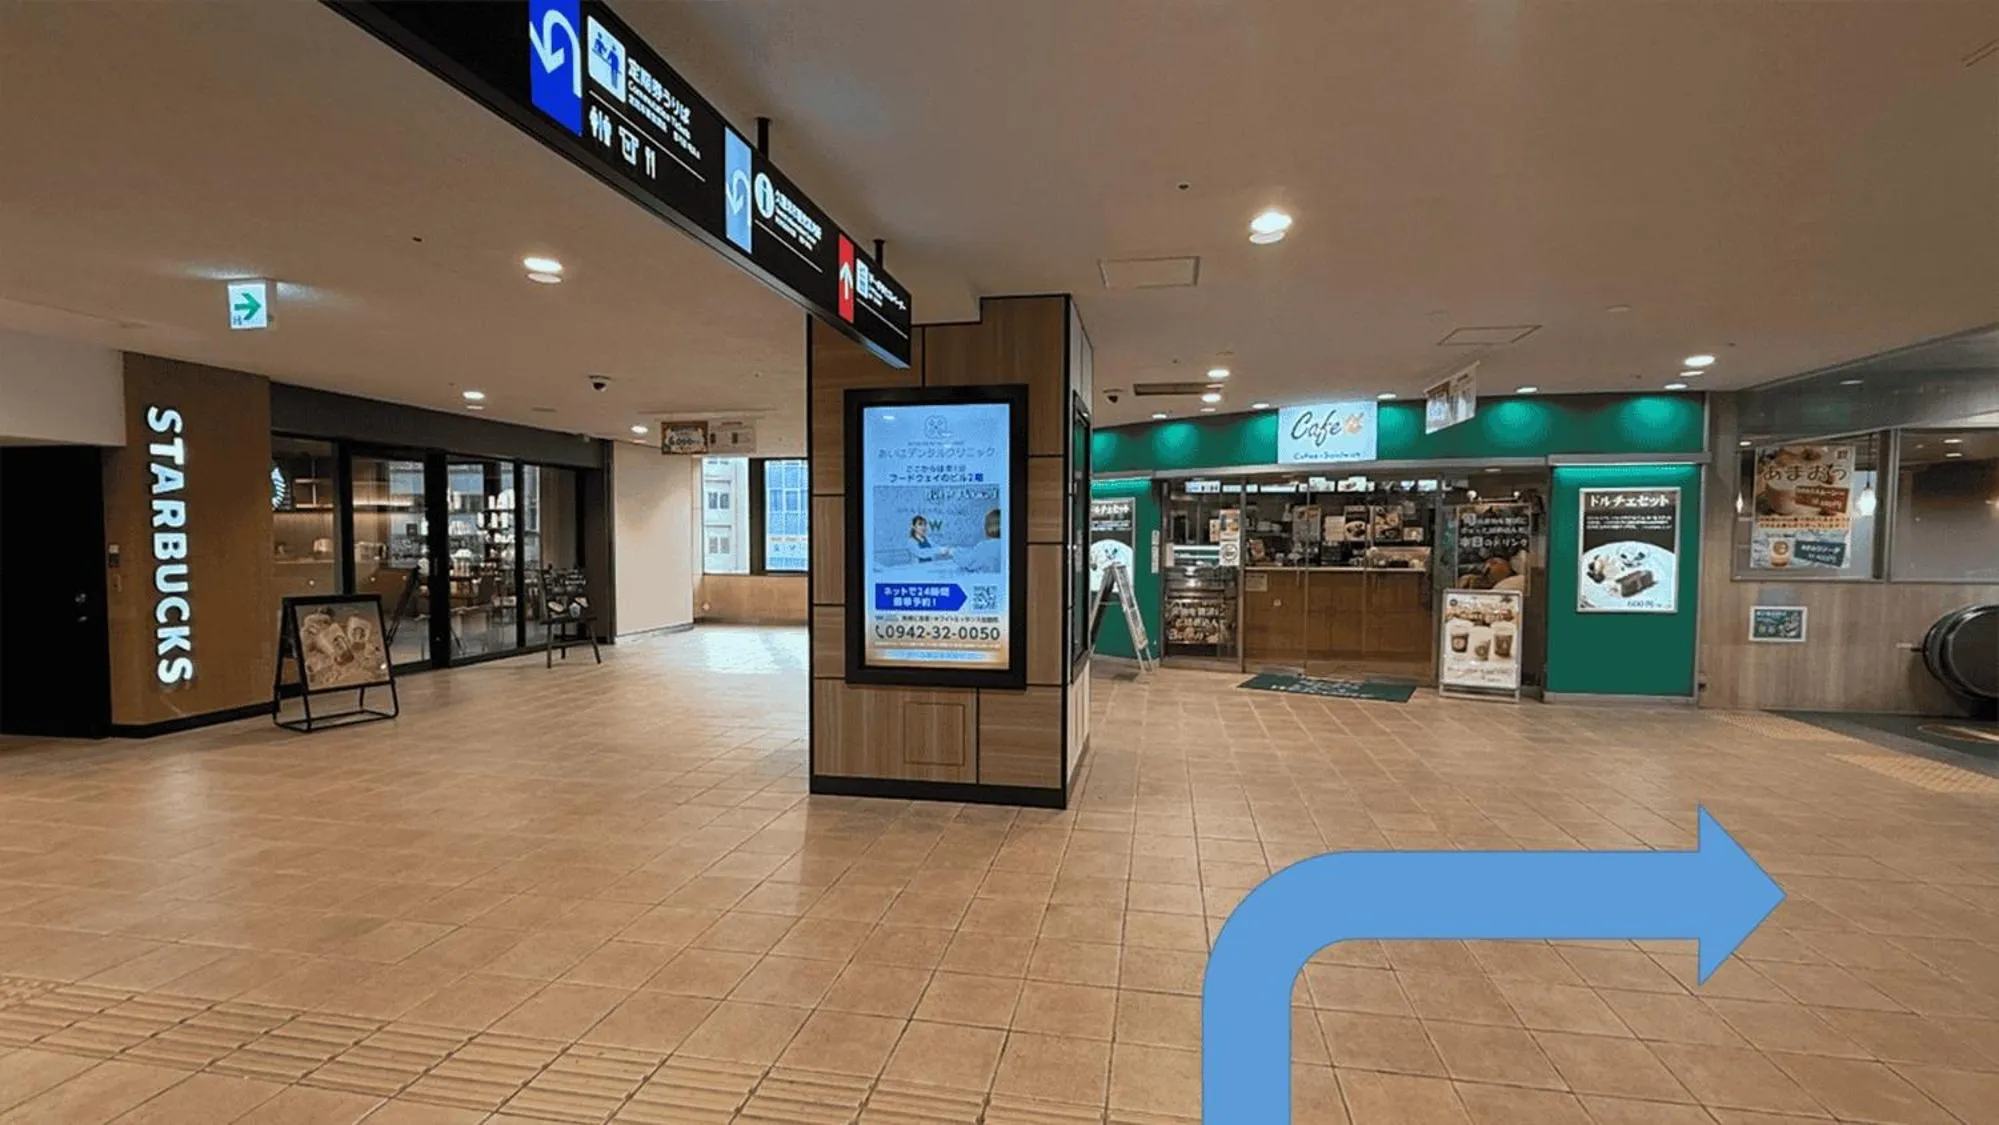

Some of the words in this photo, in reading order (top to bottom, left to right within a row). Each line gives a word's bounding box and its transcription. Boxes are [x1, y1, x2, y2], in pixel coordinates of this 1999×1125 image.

[1590, 494, 1669, 508] ドルチェセット
[147, 405, 193, 686] STARBUCKS
[884, 586, 950, 597] ネットで24時間
[885, 625, 1000, 641] 0942-32-0050
